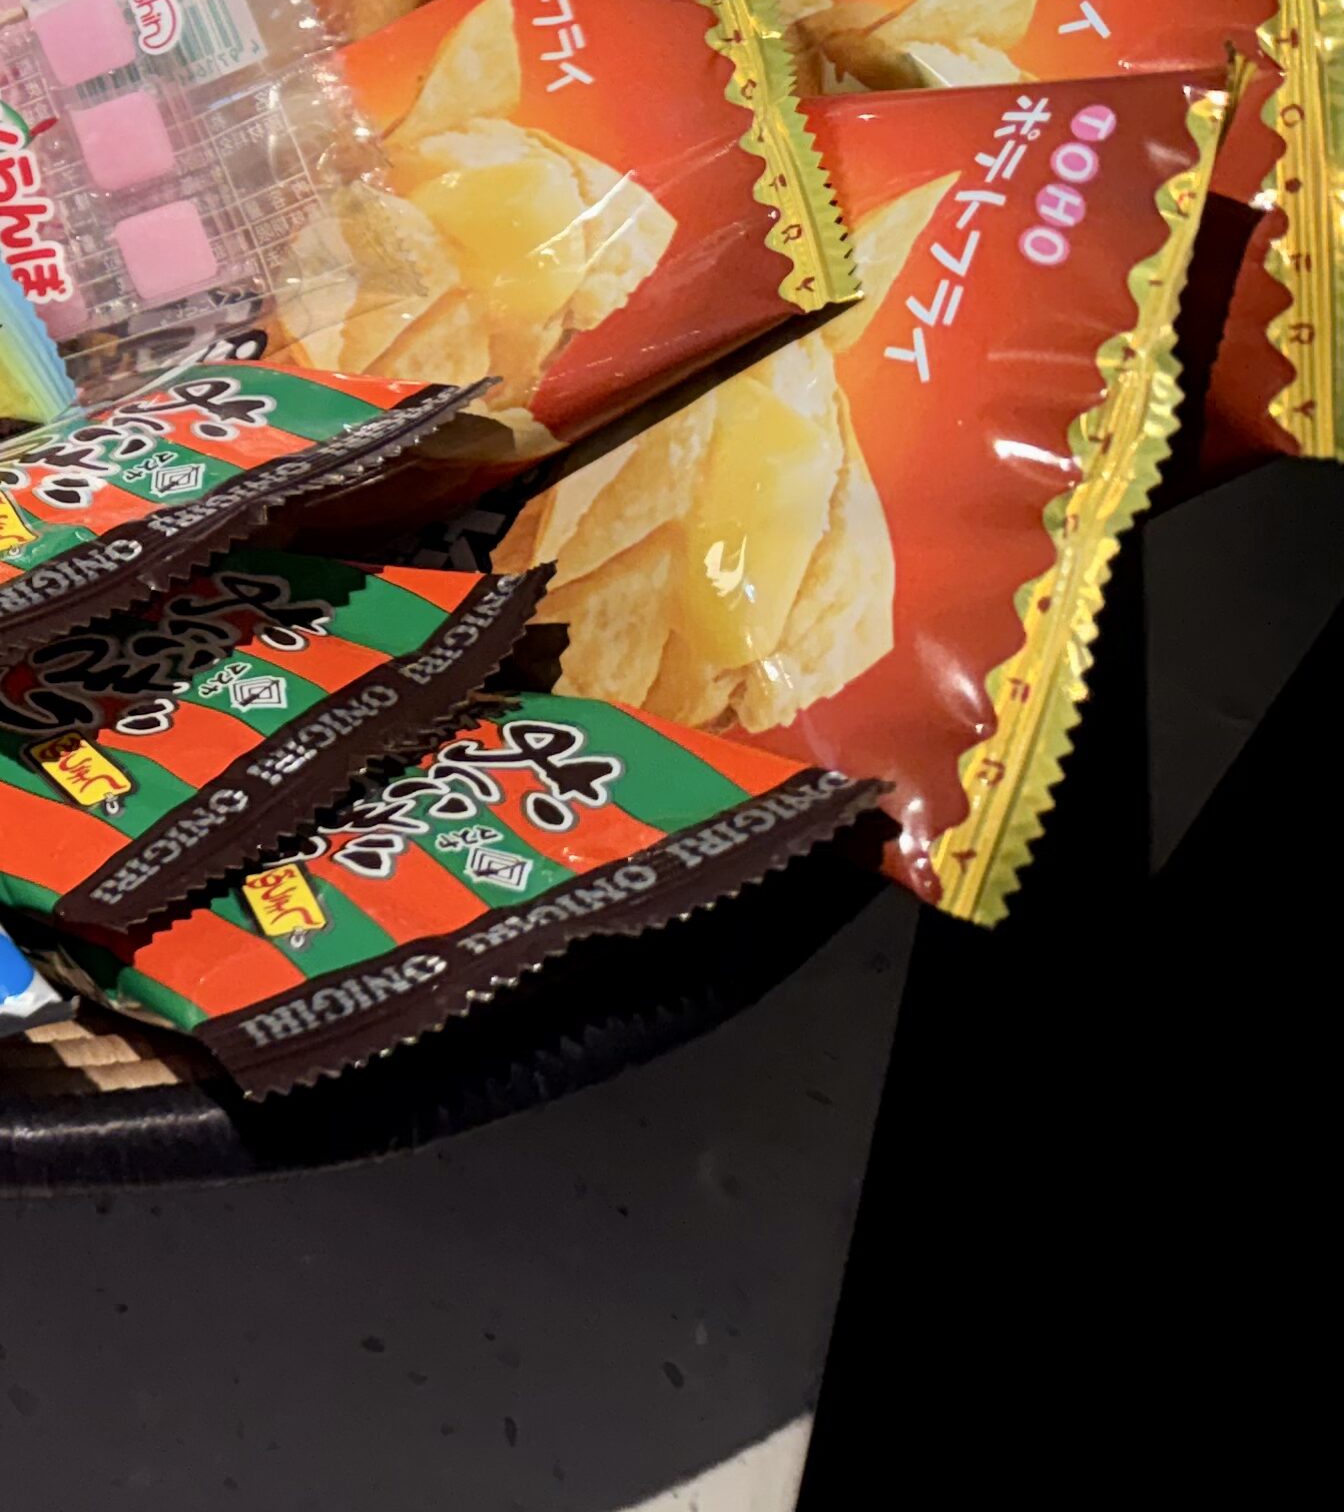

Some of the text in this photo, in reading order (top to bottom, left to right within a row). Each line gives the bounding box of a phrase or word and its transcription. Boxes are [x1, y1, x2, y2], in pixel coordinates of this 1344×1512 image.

[880, 95, 1056, 382] ポテトフライ
[1019, 114, 1116, 264] TOHO
[122, 447, 171, 483] マスヤ
[194, 657, 247, 702] マスヤ
[84, 778, 250, 913] ONIGIRI
[246, 675, 399, 791] ONIGIRI
[432, 817, 499, 857] マスヤ
[240, 947, 446, 1048] ONIGIRI
